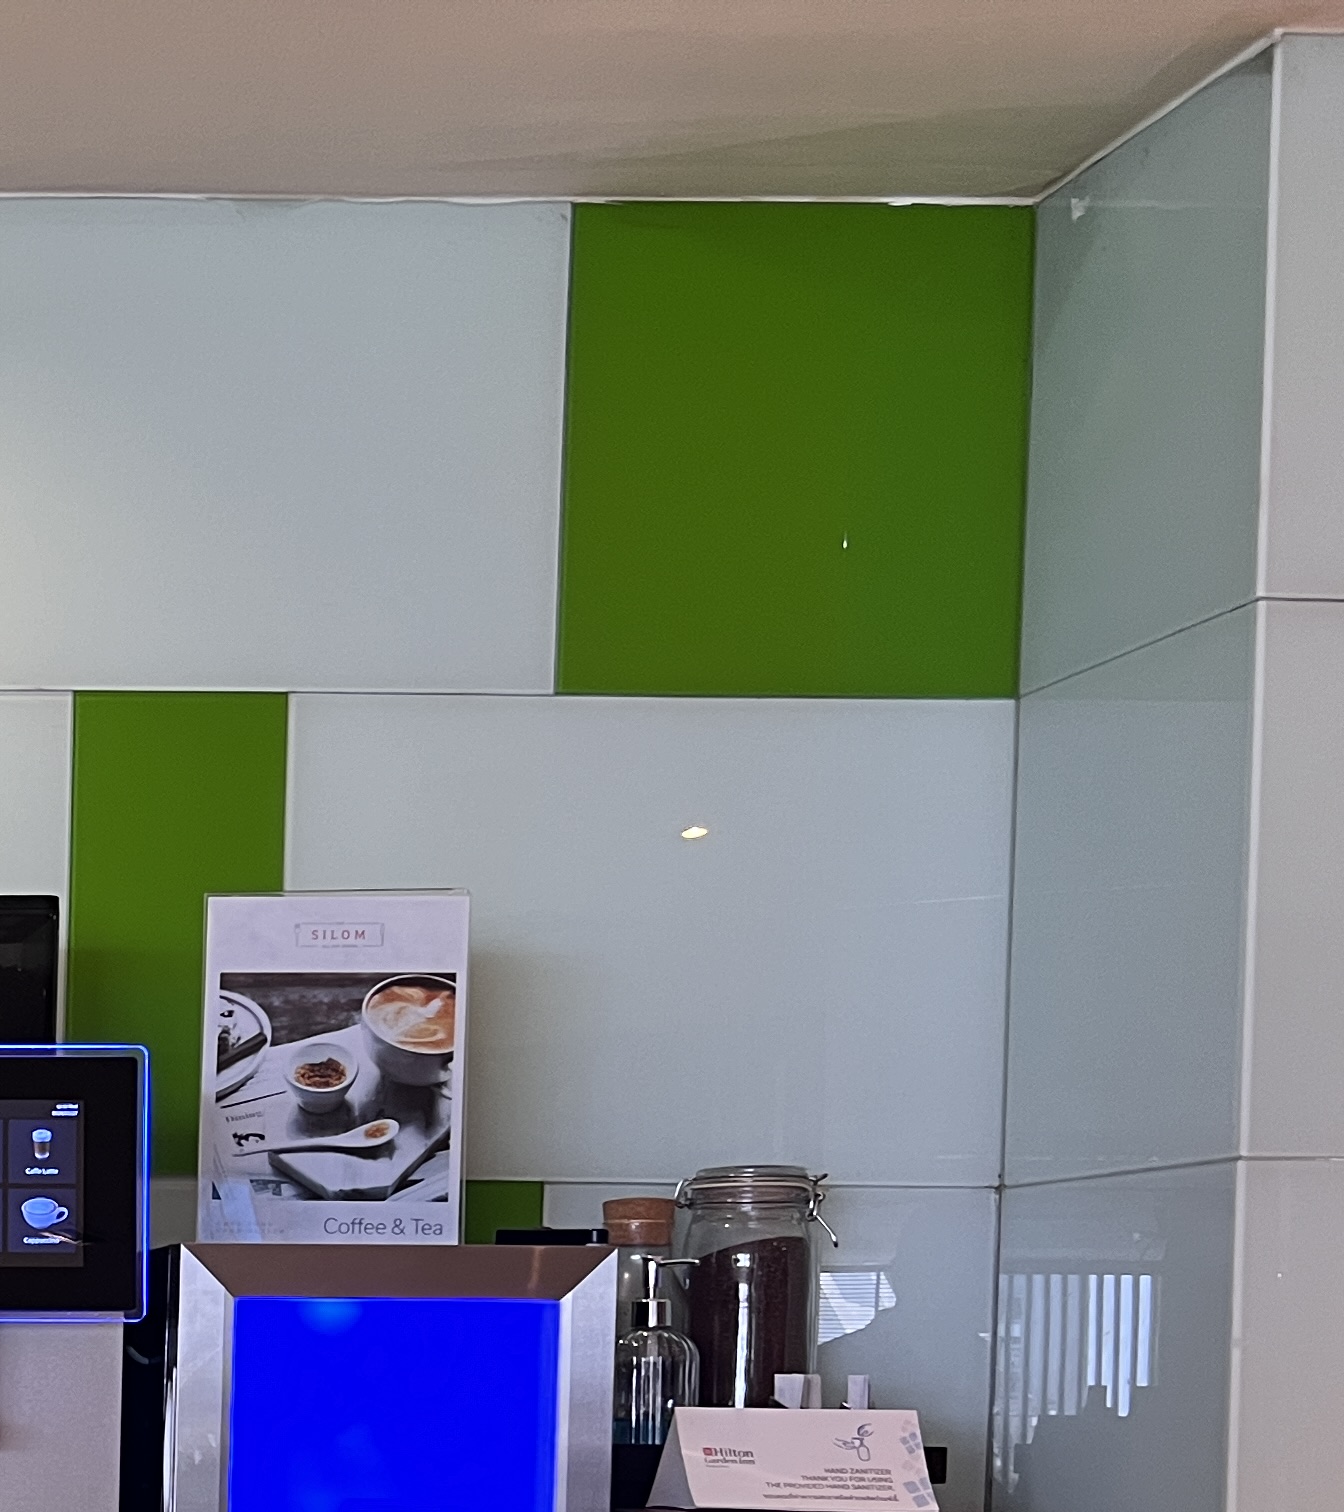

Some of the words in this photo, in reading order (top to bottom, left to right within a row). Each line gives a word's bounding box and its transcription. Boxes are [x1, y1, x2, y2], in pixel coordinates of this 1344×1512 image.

[311, 929, 366, 940] SILOM
[323, 1217, 387, 1235] Coffee
[391, 1218, 406, 1235] &
[410, 1218, 443, 1235] Tea
[713, 1447, 754, 1458] Hilton
[800, 1474, 829, 1482] THANK
[829, 1475, 849, 1483] YOU
